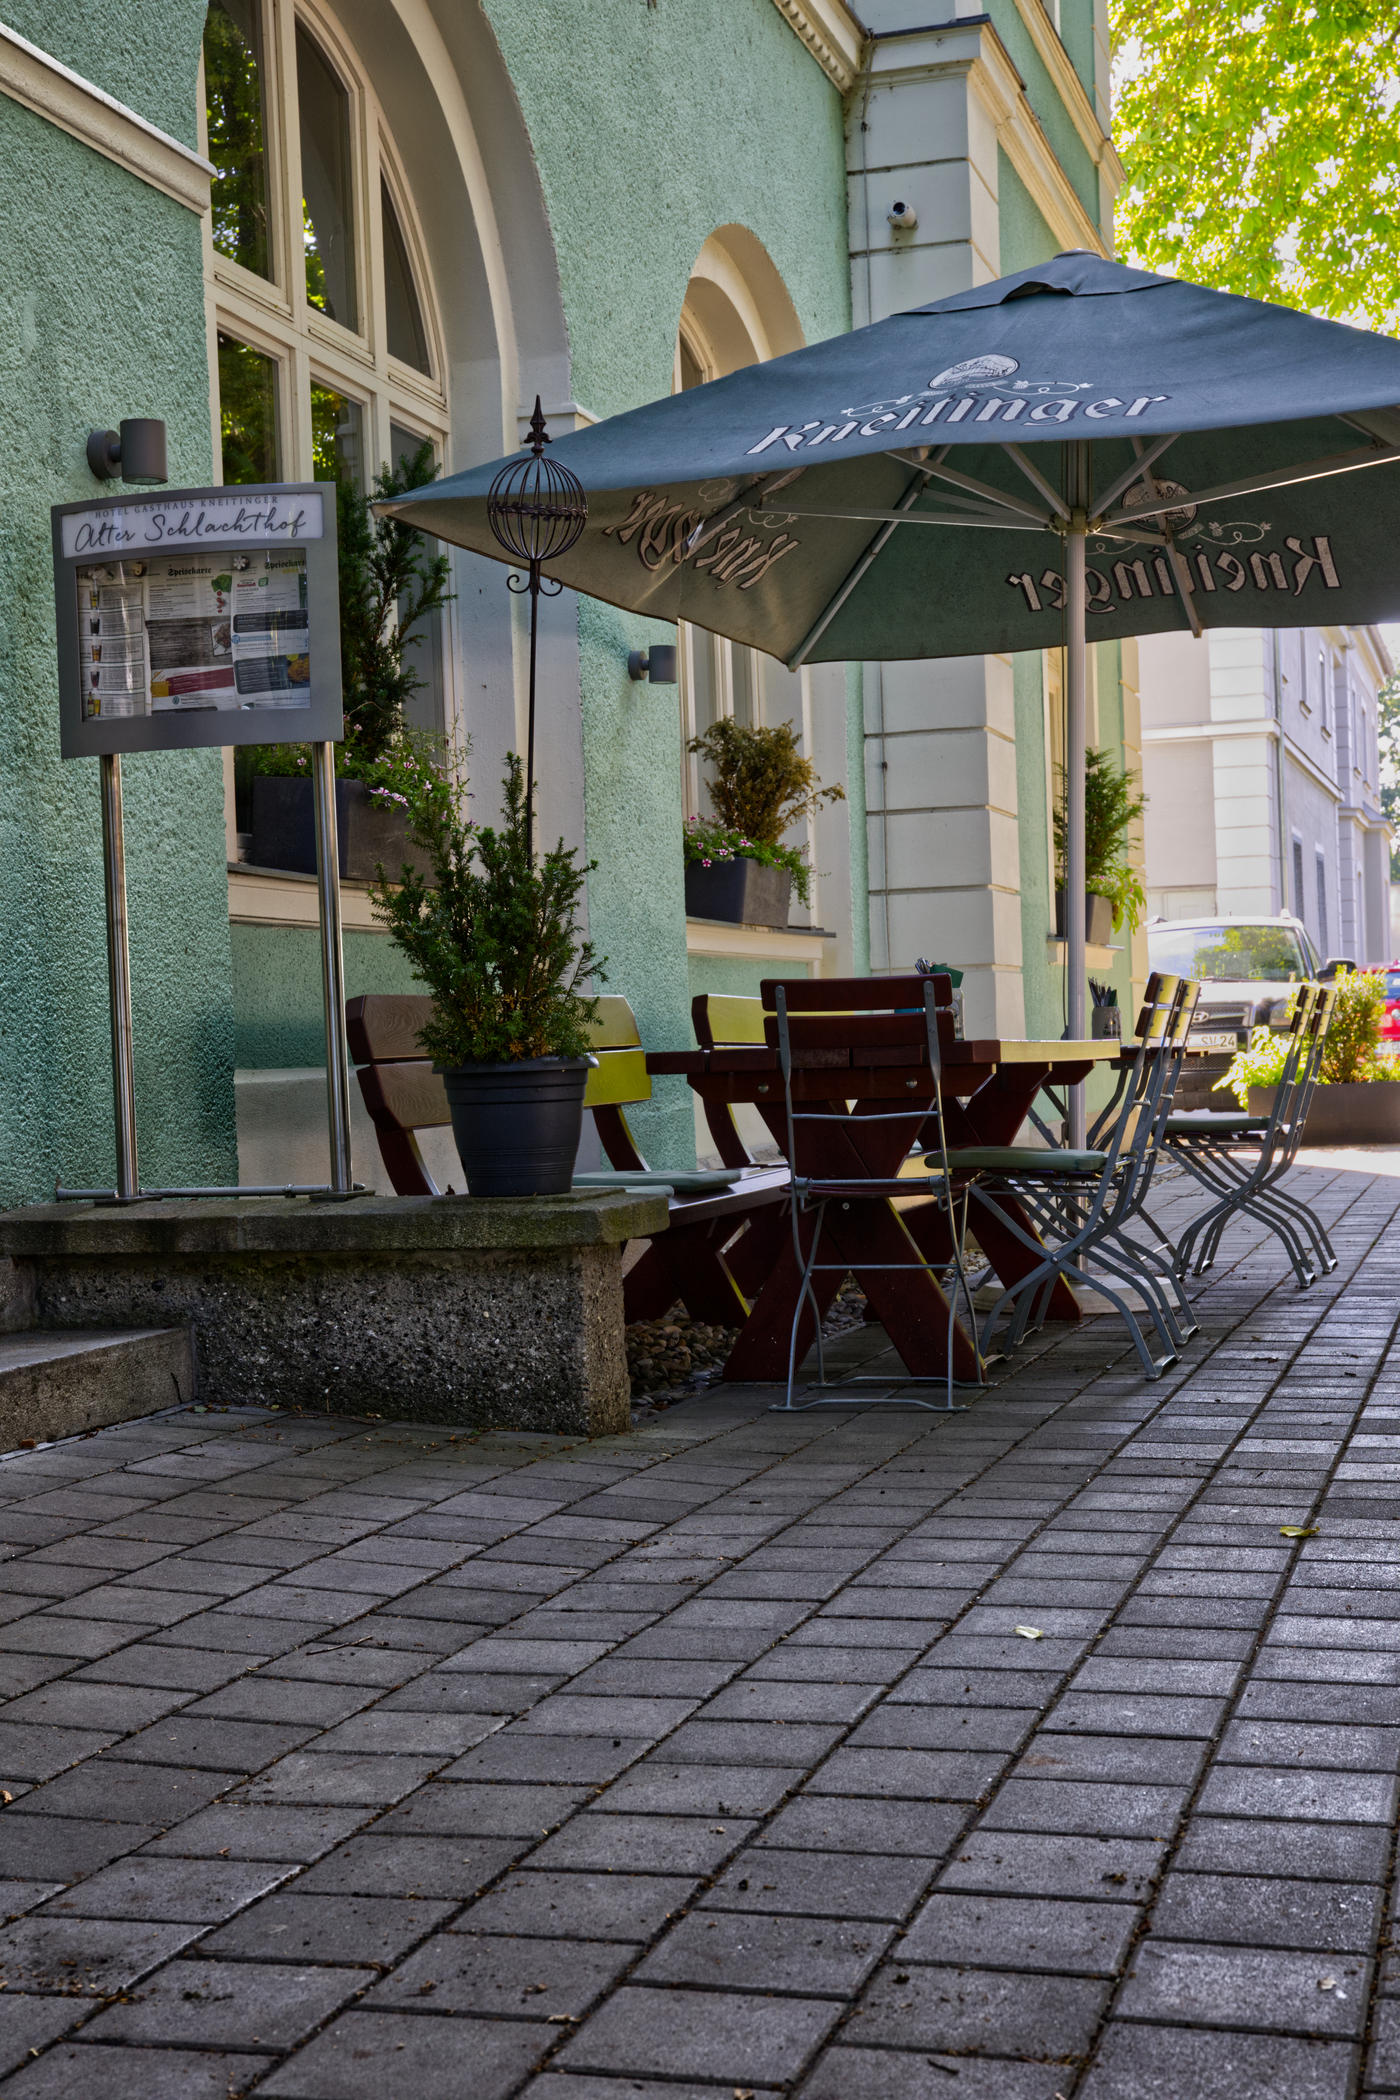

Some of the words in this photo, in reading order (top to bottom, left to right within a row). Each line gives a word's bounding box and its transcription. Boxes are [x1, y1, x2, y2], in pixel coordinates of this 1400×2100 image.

[744, 391, 1172, 456] Kneitinger
[95, 508, 129, 519] HOTEL
[134, 501, 195, 514] GASTHAUS
[200, 495, 279, 507] KNEITINGER
[74, 523, 136, 552] Alter
[144, 507, 306, 541] Schlachthof
[1219, 1034, 1236, 1048] 24
